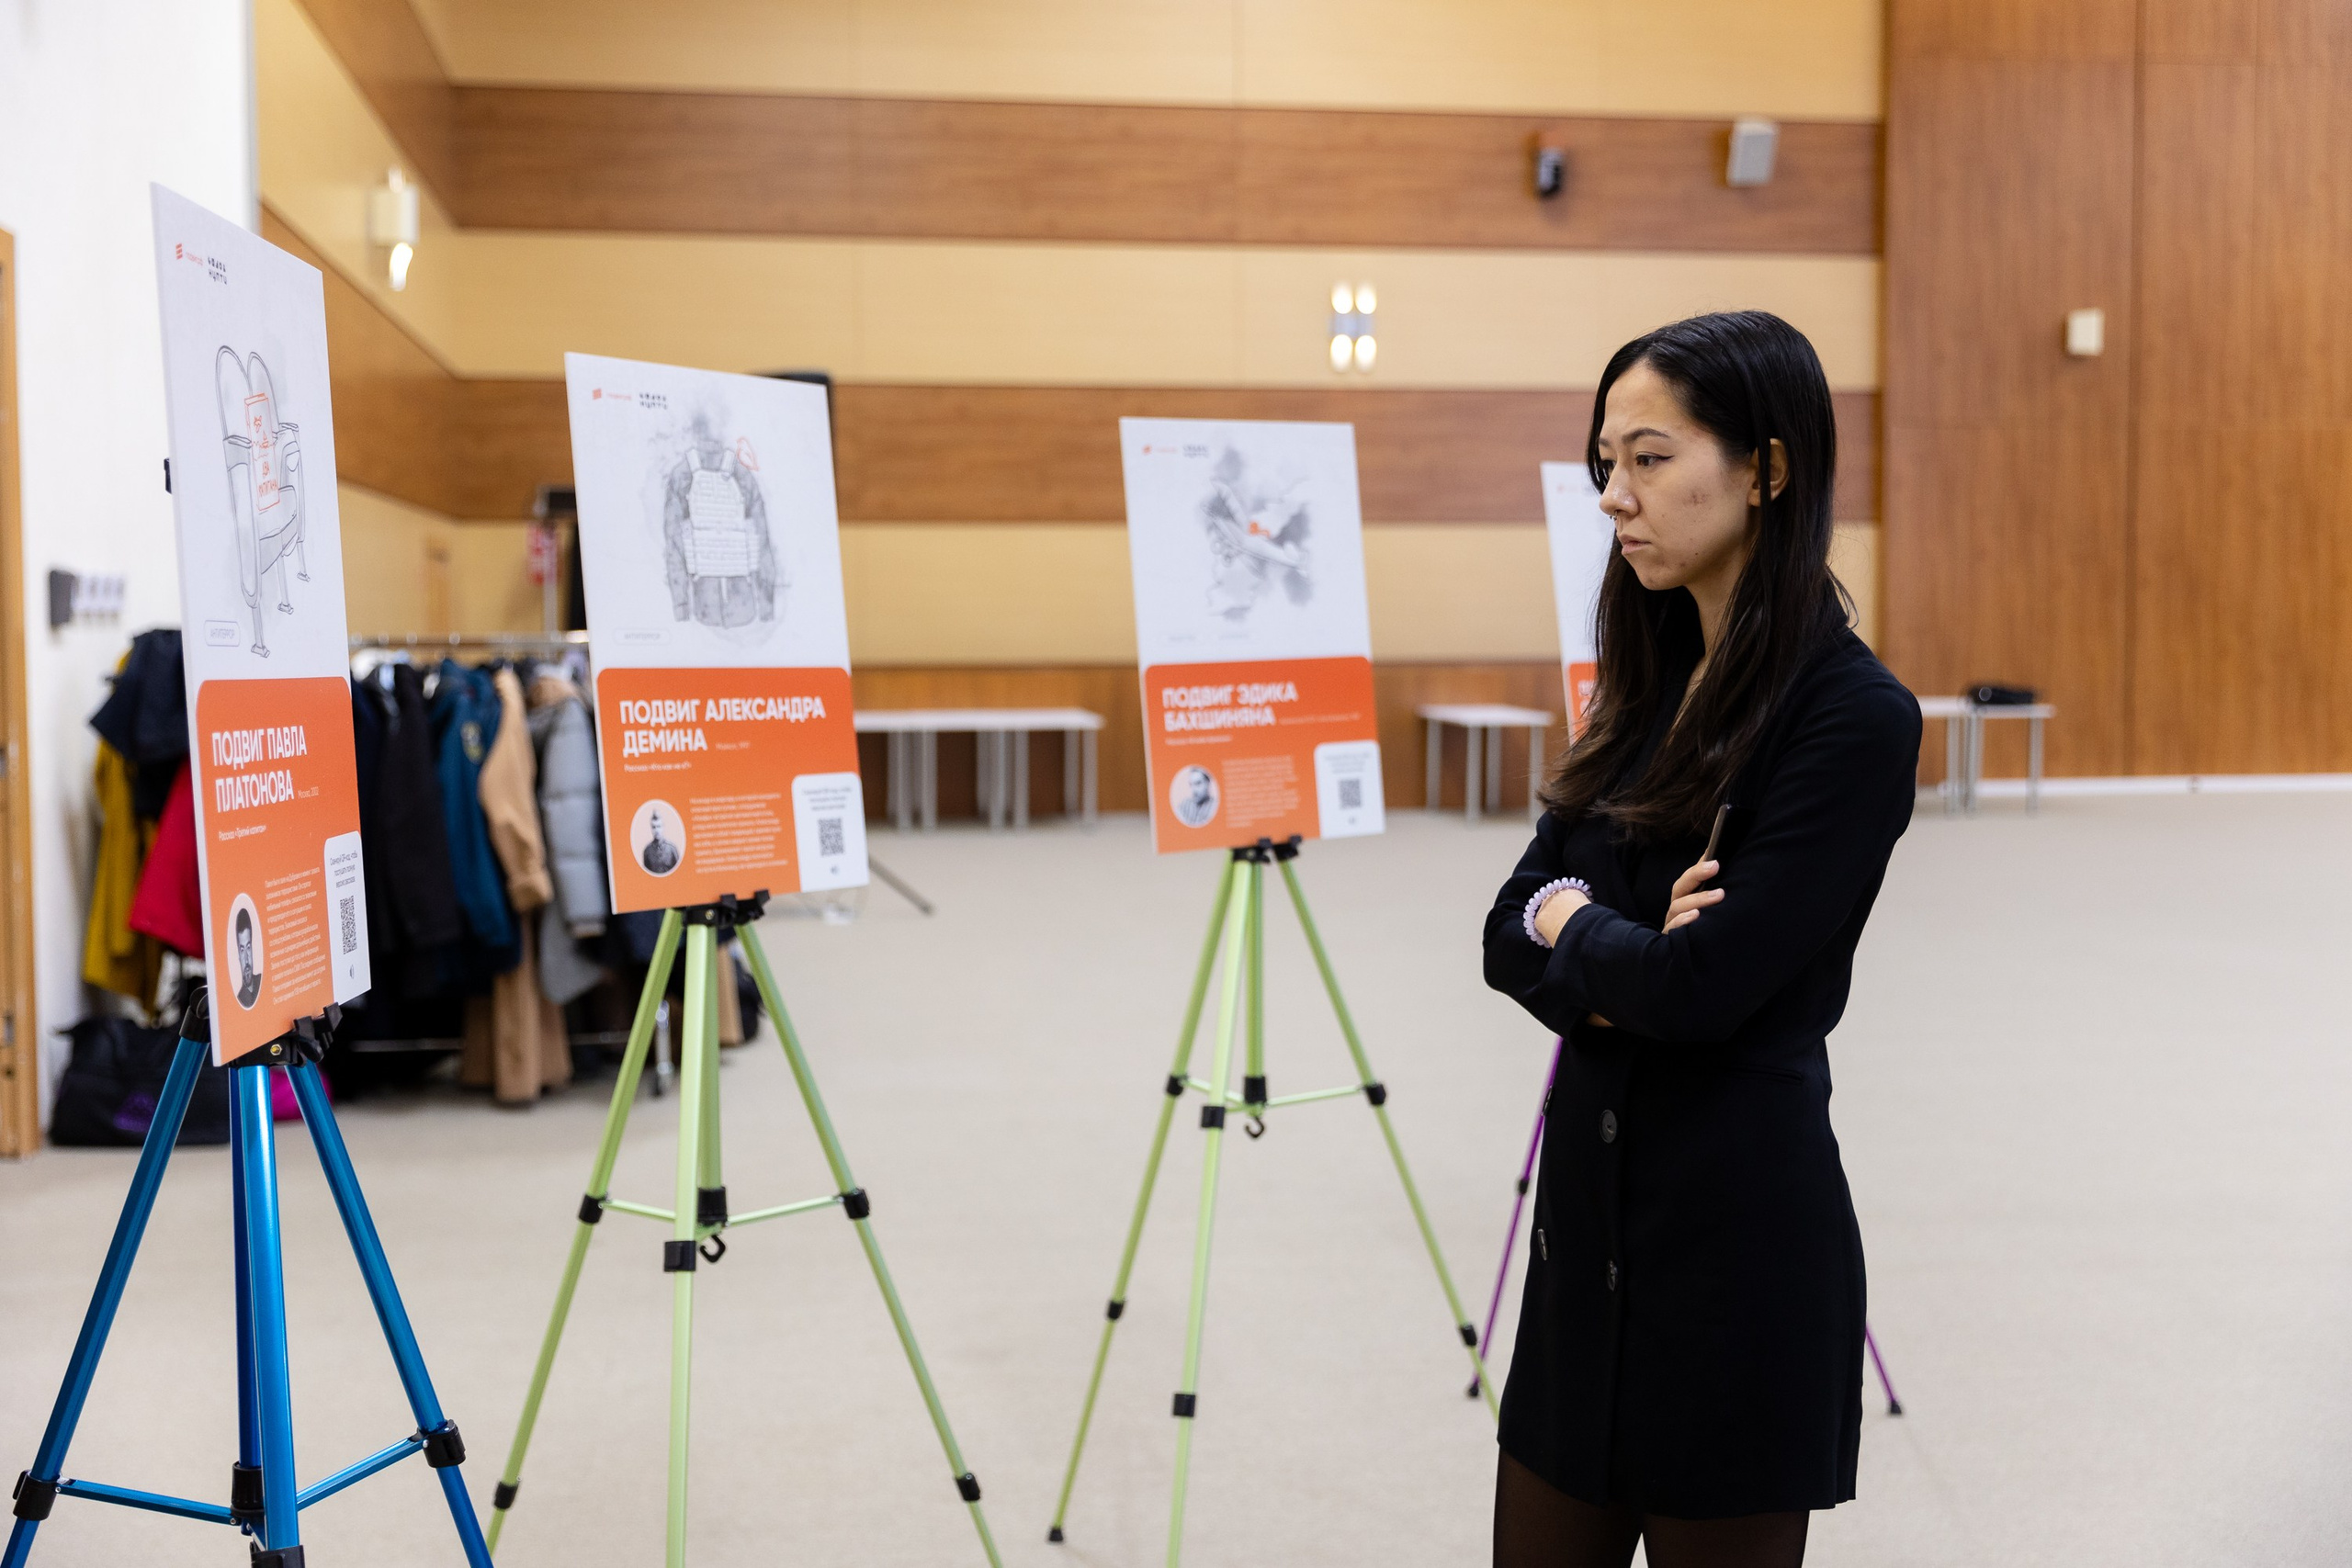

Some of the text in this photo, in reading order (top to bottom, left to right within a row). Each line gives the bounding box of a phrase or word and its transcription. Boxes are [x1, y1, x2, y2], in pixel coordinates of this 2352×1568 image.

[1162, 682, 1298, 708] ПОДВИГ ЭДИКА
[619, 696, 825, 727] ПОДВИГ АЛЕКСАНДРА
[1164, 706, 1276, 732] БАХШИНЯНА
[211, 725, 307, 770] ПОДВИГ ПАВЛА
[622, 728, 707, 757] ДЕМИНА
[215, 769, 295, 813] ПЛАТОНОВА
